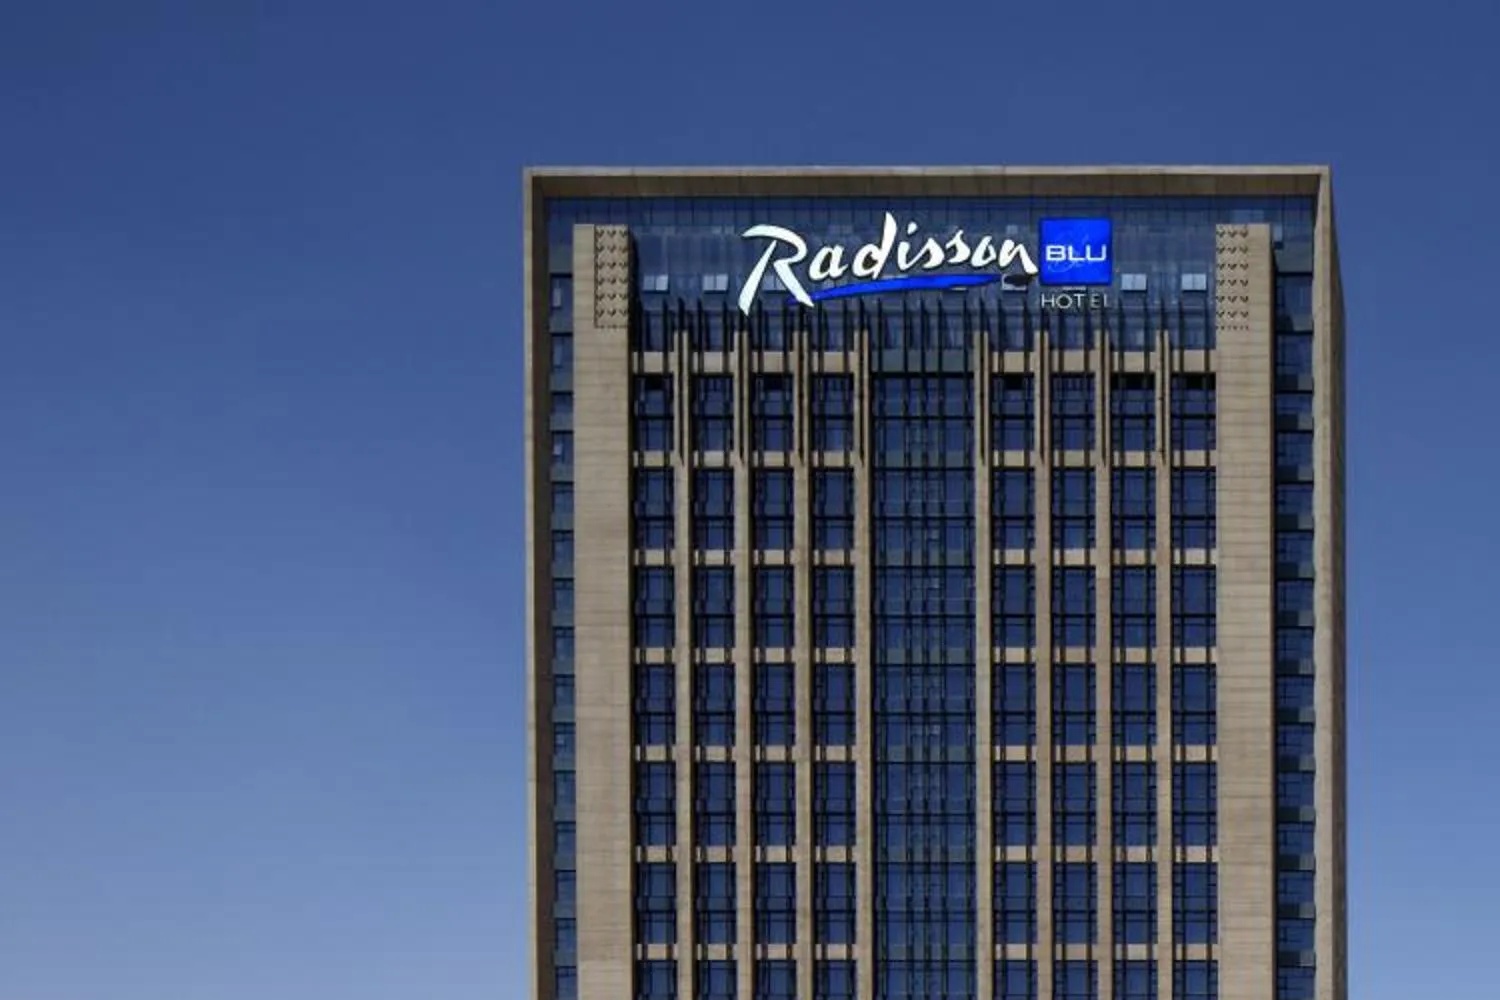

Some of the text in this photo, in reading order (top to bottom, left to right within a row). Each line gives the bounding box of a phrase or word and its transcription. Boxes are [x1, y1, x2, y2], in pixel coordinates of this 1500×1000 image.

[738, 211, 1107, 316] Radisson BLU
[1041, 293, 1111, 309] HOTEL
